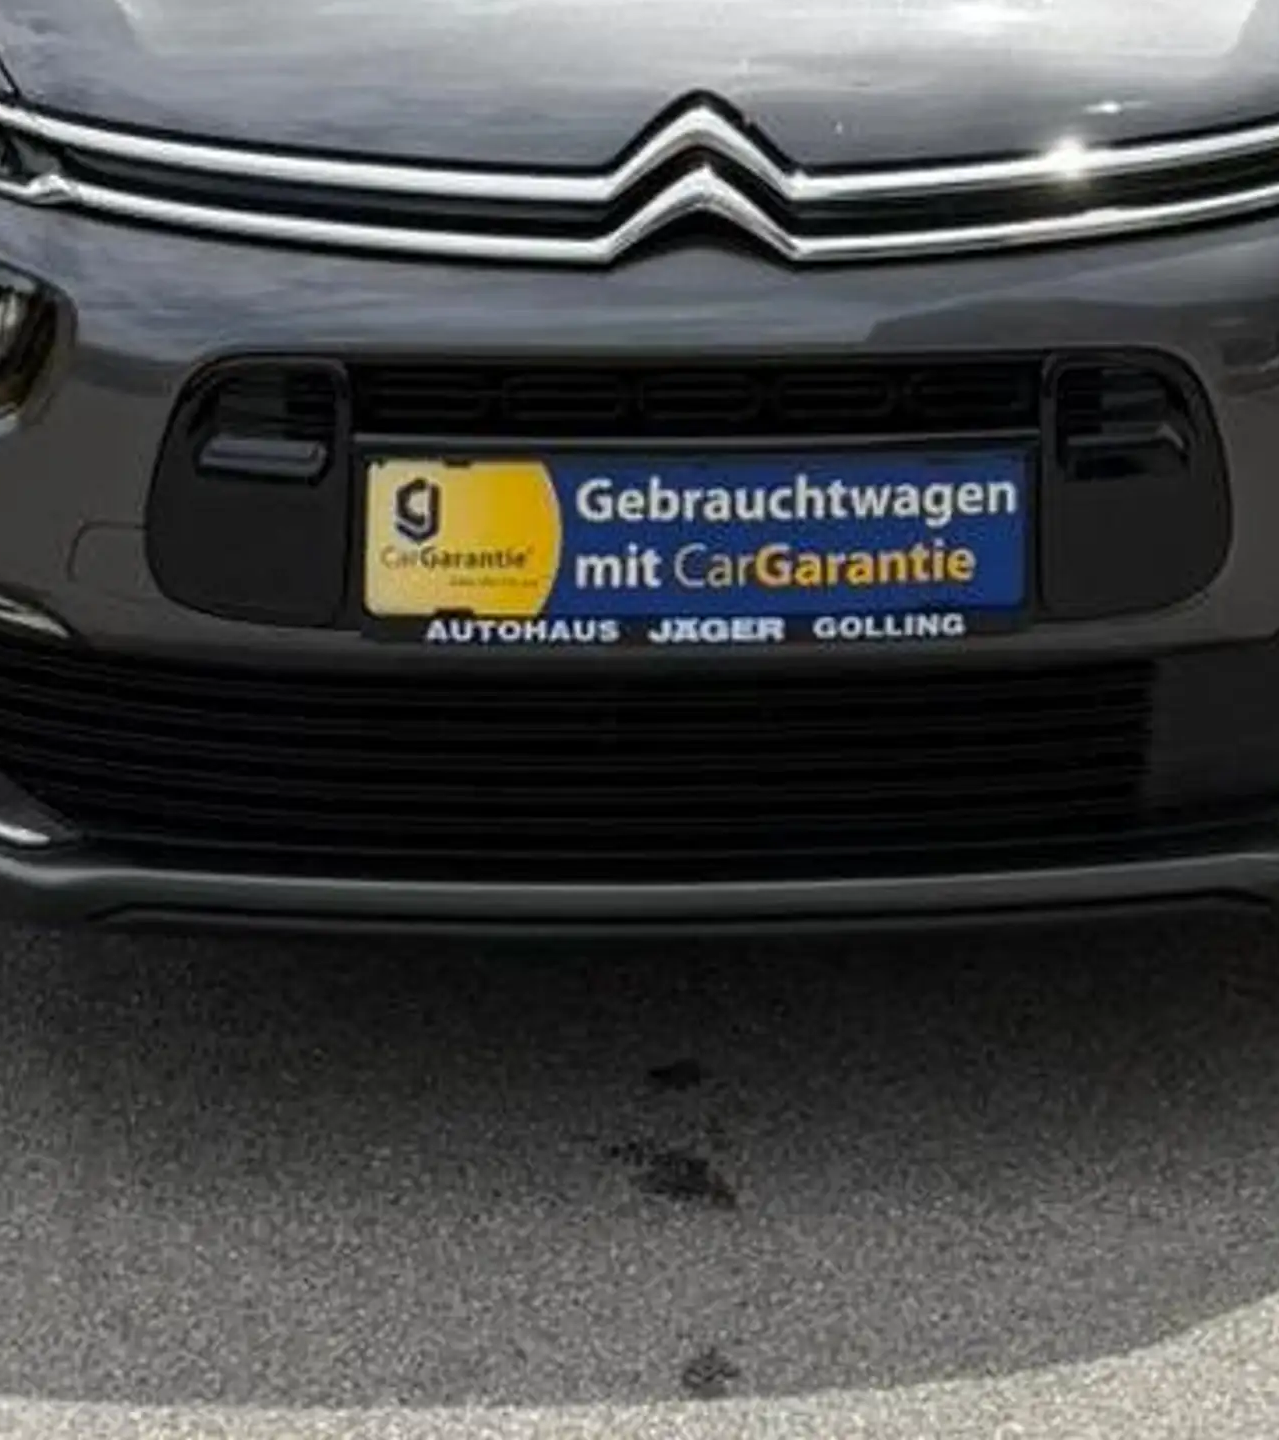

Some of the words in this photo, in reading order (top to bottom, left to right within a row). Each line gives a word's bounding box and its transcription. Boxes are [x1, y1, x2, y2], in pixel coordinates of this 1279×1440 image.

[576, 474, 1018, 528] Gebrauchtwagen
[575, 542, 662, 589] mit
[674, 538, 977, 588] CarGarantie
[425, 619, 621, 643] AUTOHAUS
[648, 616, 785, 643] JÄGER
[812, 613, 967, 639] GOLLING
